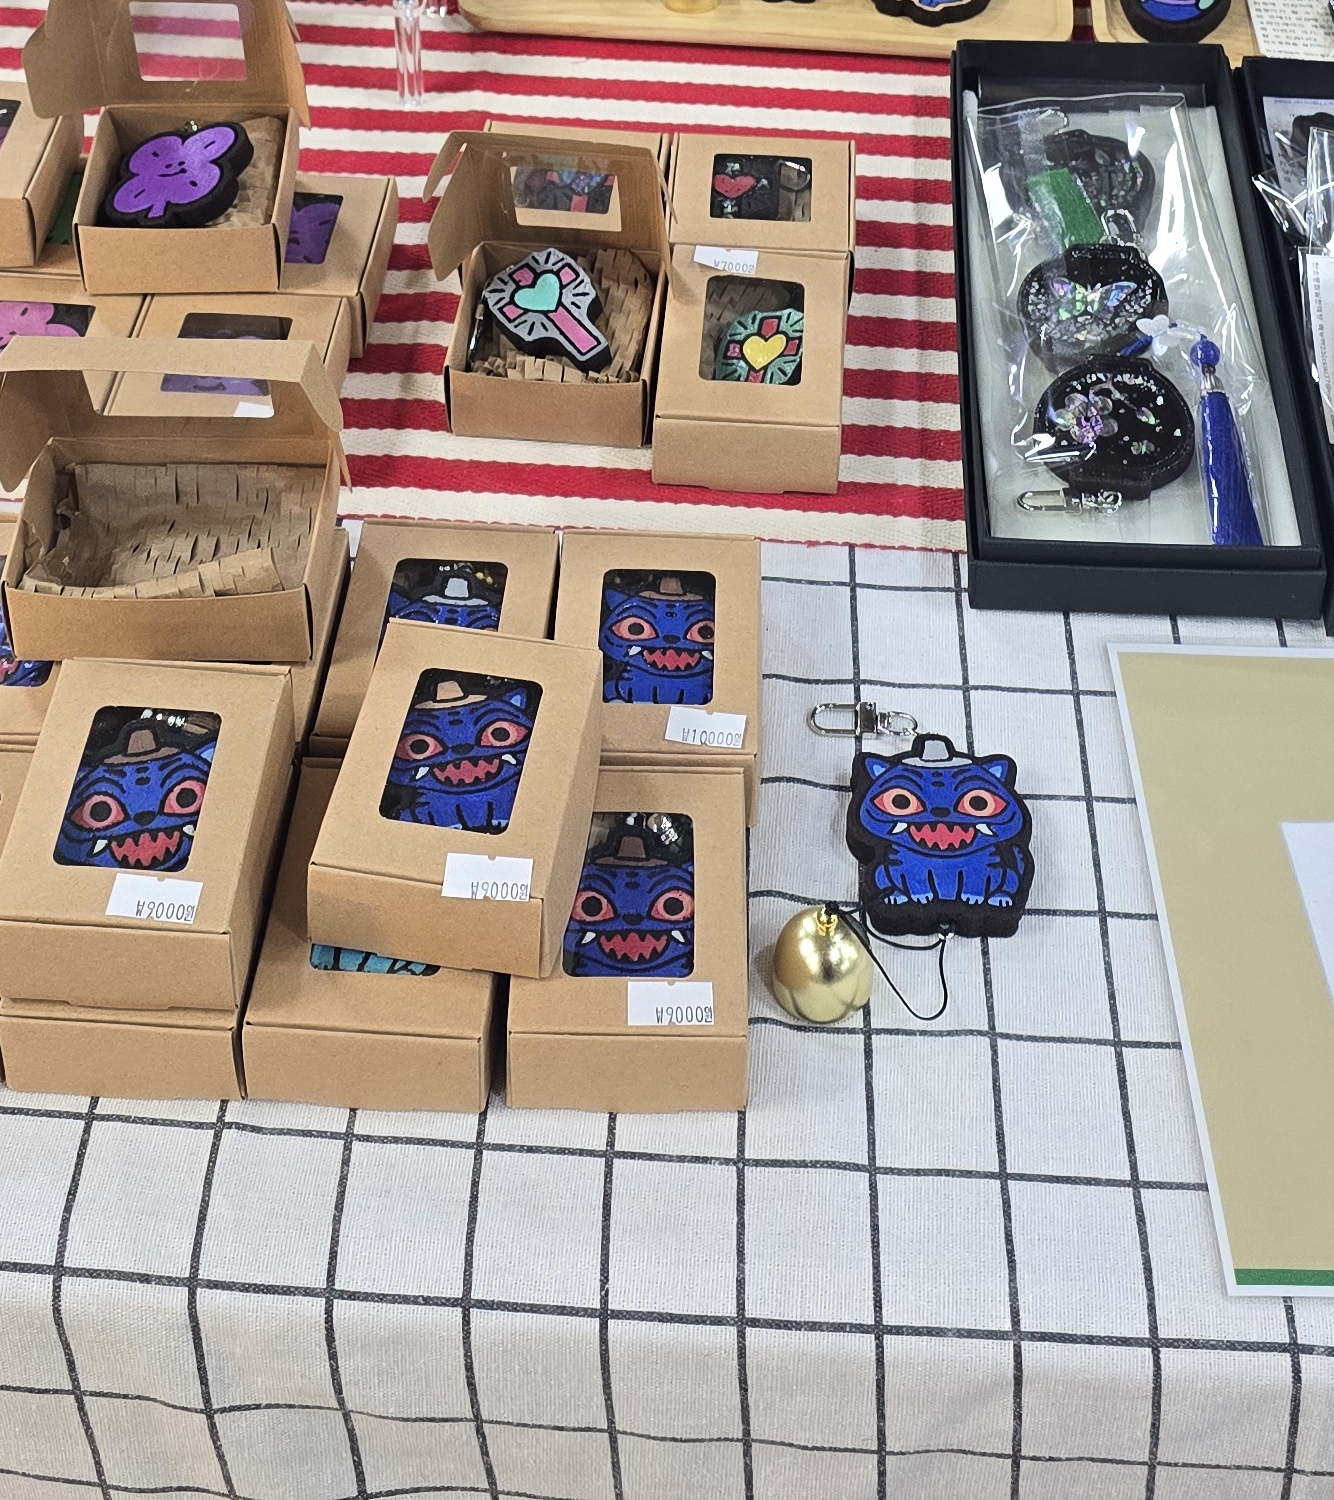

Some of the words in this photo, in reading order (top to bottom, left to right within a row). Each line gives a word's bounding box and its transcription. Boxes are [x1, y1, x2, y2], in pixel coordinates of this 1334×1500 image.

[471, 880, 528, 902] ₩9000원
[135, 900, 195, 922] ₩9000원
[655, 1005, 713, 1025] ₩9000원
